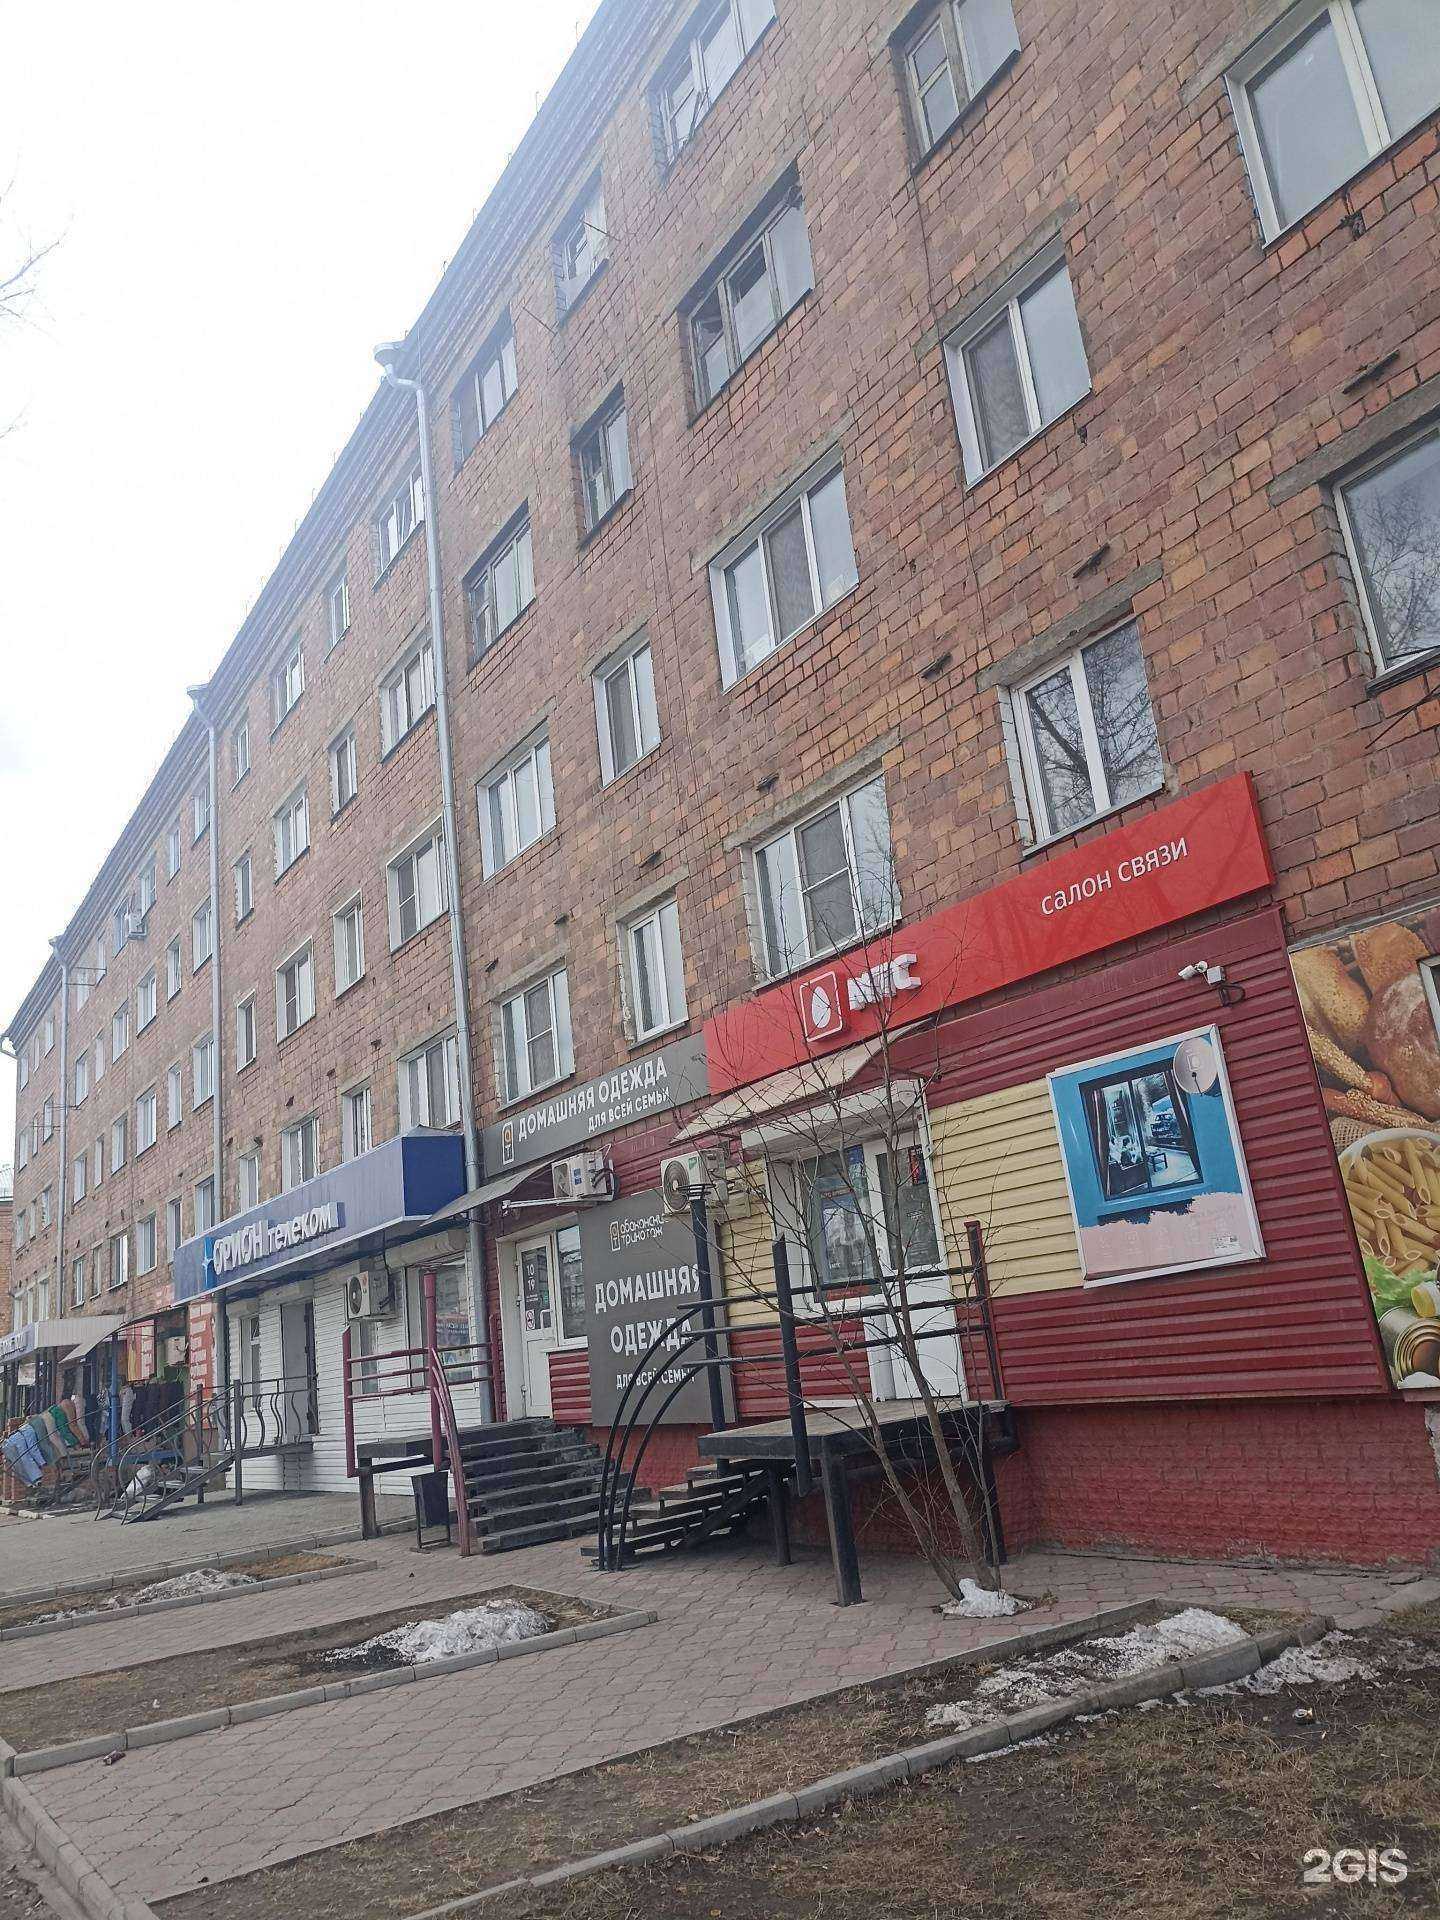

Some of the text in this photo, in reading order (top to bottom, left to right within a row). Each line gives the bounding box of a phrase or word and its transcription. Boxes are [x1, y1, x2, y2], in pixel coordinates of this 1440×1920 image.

[1041, 837, 1189, 915] салон связи
[847, 953, 922, 1011] МТС
[518, 1056, 668, 1142] ДОМАШНЯЯ ОДЕЖДА
[588, 1086, 670, 1134] ДЛЯ ВСЕЙ СЕМЬИ
[213, 1219, 269, 1276] ОРИОН
[595, 1263, 700, 1314] ДОМАШНЯЯ
[610, 1317, 695, 1356] ОДЕЖДА
